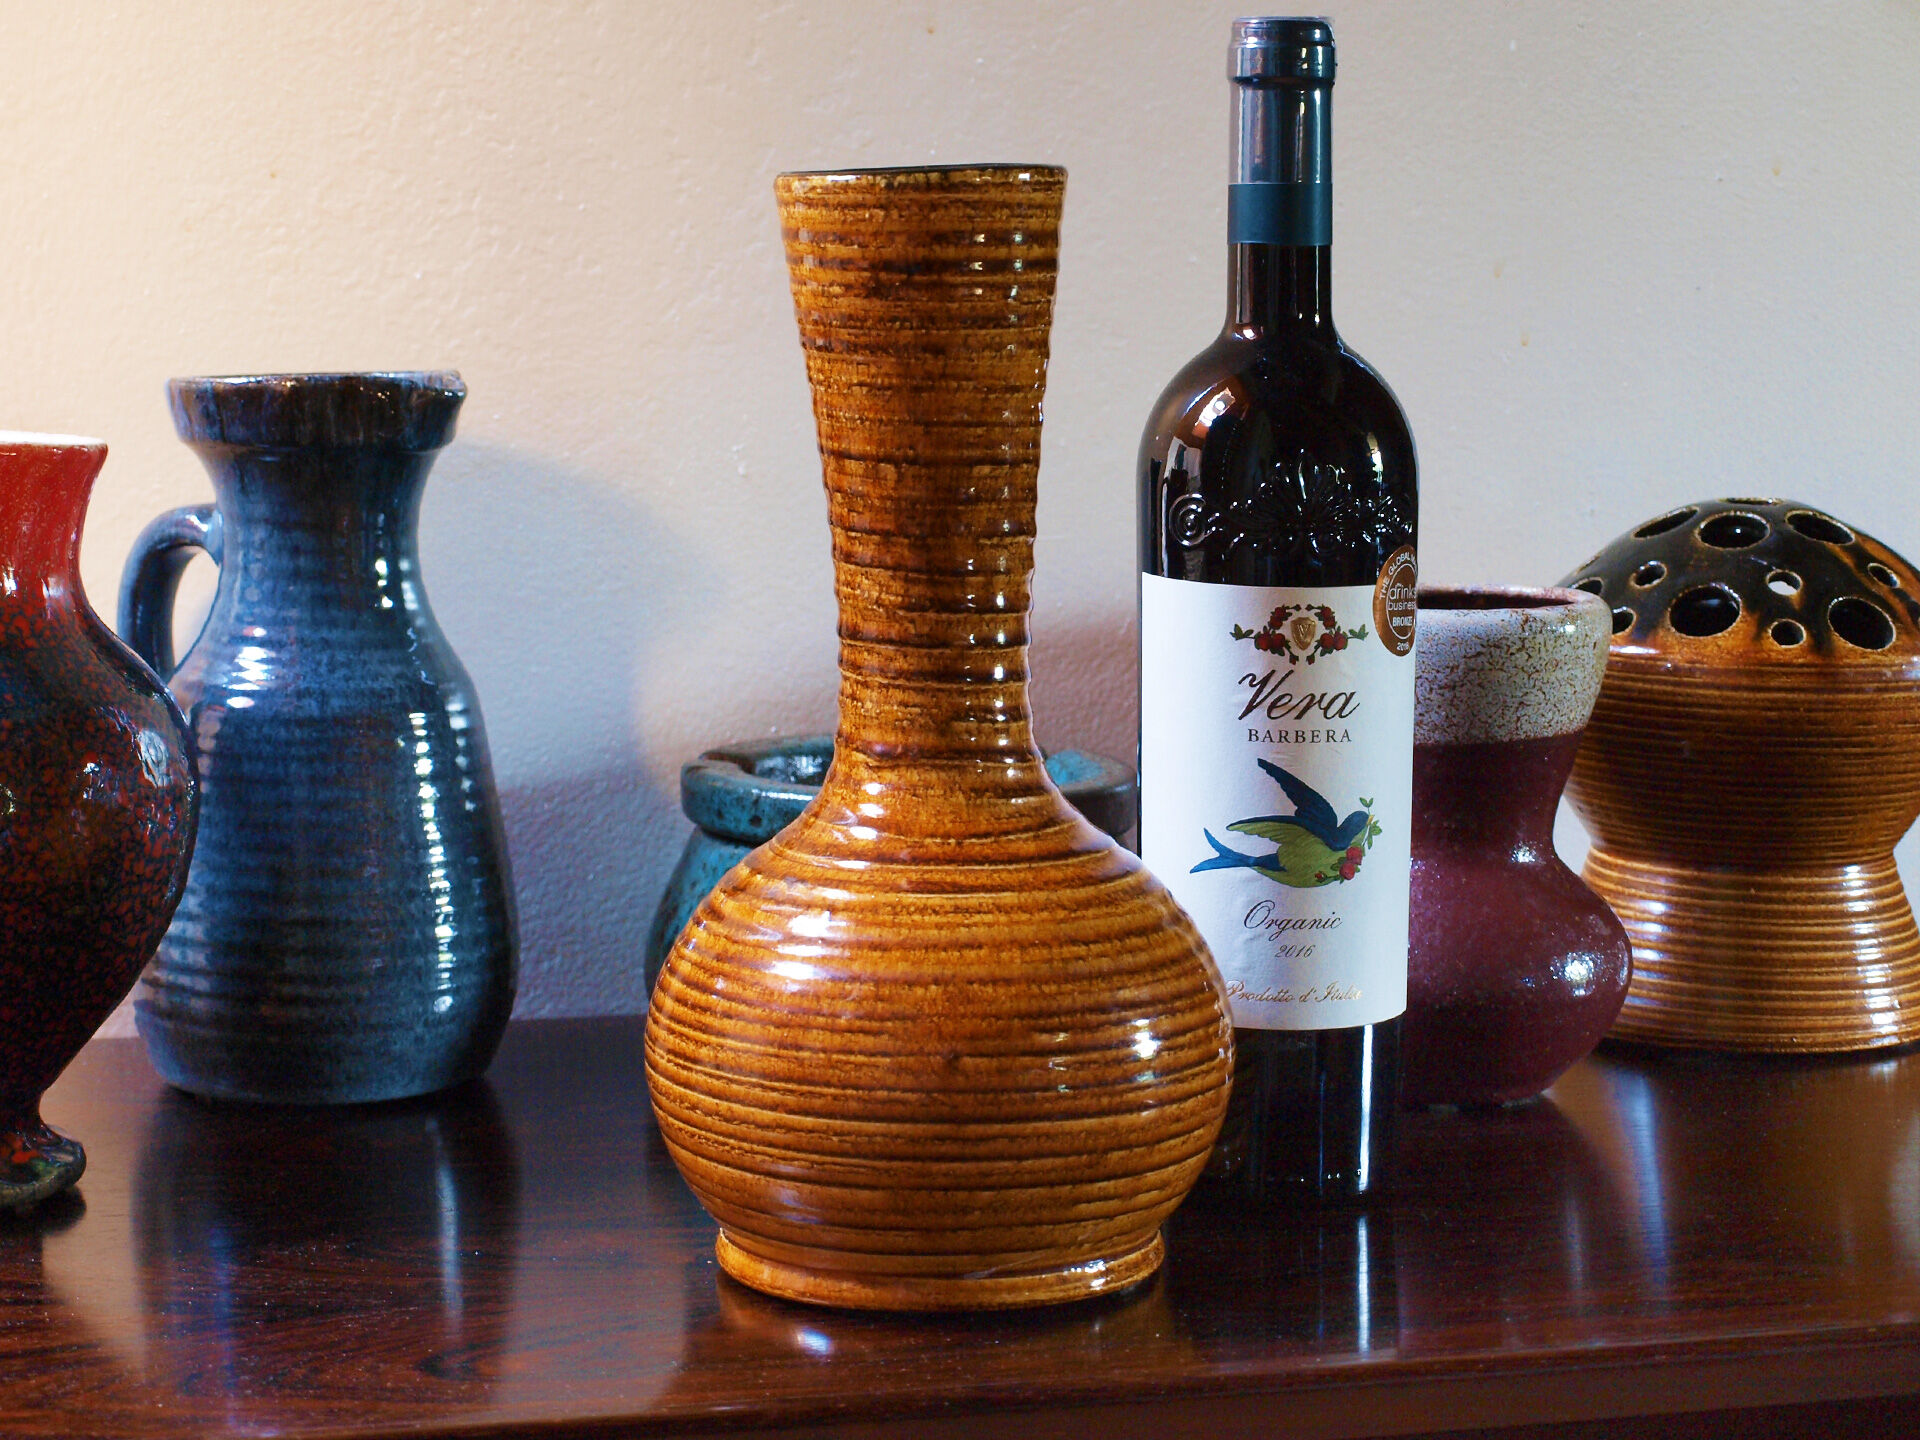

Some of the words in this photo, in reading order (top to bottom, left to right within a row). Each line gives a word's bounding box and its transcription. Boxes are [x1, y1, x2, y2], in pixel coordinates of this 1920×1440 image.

[1380, 576, 1390, 599] THE
[1392, 616, 1413, 627] BRONZE
[1238, 669, 1360, 721] Vera
[1248, 728, 1352, 743] BARBERA
[1244, 899, 1342, 942] Organic
[1274, 944, 1316, 958] 2016
[1225, 979, 1296, 1003] Prodotto
